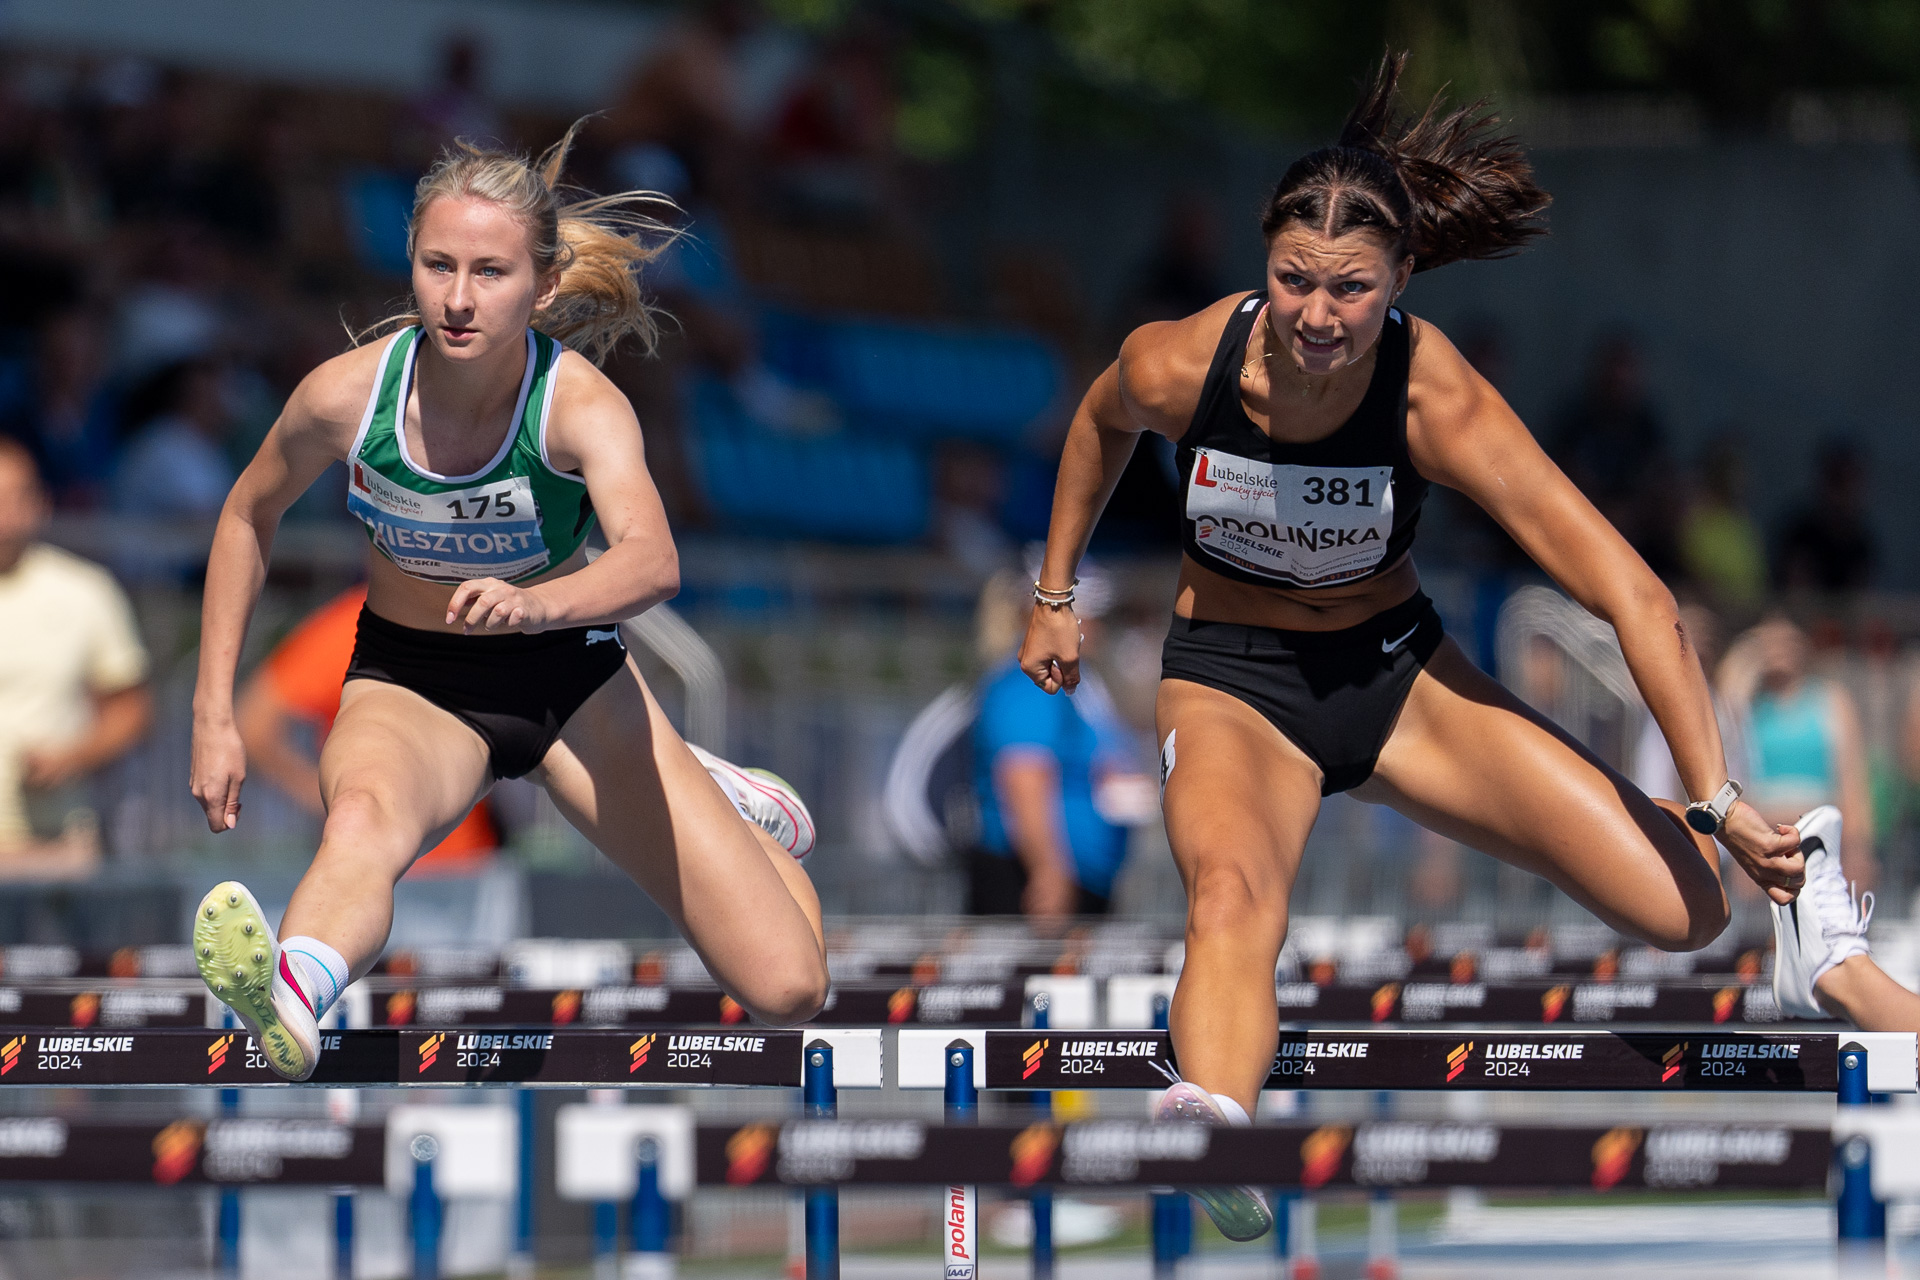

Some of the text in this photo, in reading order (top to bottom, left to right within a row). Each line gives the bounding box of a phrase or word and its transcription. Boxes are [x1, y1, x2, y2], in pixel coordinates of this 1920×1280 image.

[1302, 476, 1374, 507] 381
[446, 490, 516, 519] 175
[1219, 538, 1248, 556] 2024
[1221, 531, 1285, 559] LUBELSKIE
[393, 554, 441, 567] ELSKIE
[1225, 553, 1256, 570] LUBLIN
[38, 1037, 134, 1052] LUBELSKIE
[457, 1035, 554, 1050] LUBELSKIE
[668, 1036, 765, 1052] LUBELSKIE
[1061, 1042, 1158, 1056] LUBELSKIE
[1276, 1043, 1369, 1057] UBELSKIE
[1485, 1044, 1584, 1059] LUBELSKIE
[1701, 1044, 1801, 1059] LUBELSKIE
[38, 1055, 82, 1069] 2024
[245, 1054, 270, 1068] 20
[457, 1053, 501, 1067] 2024
[667, 1053, 712, 1068] 2024
[1060, 1059, 1105, 1074] 2024
[1270, 1060, 1315, 1074] 2024
[1485, 1062, 1530, 1076] 2024
[1701, 1062, 1746, 1076] 2024
[947, 1269, 971, 1277] IAAF
